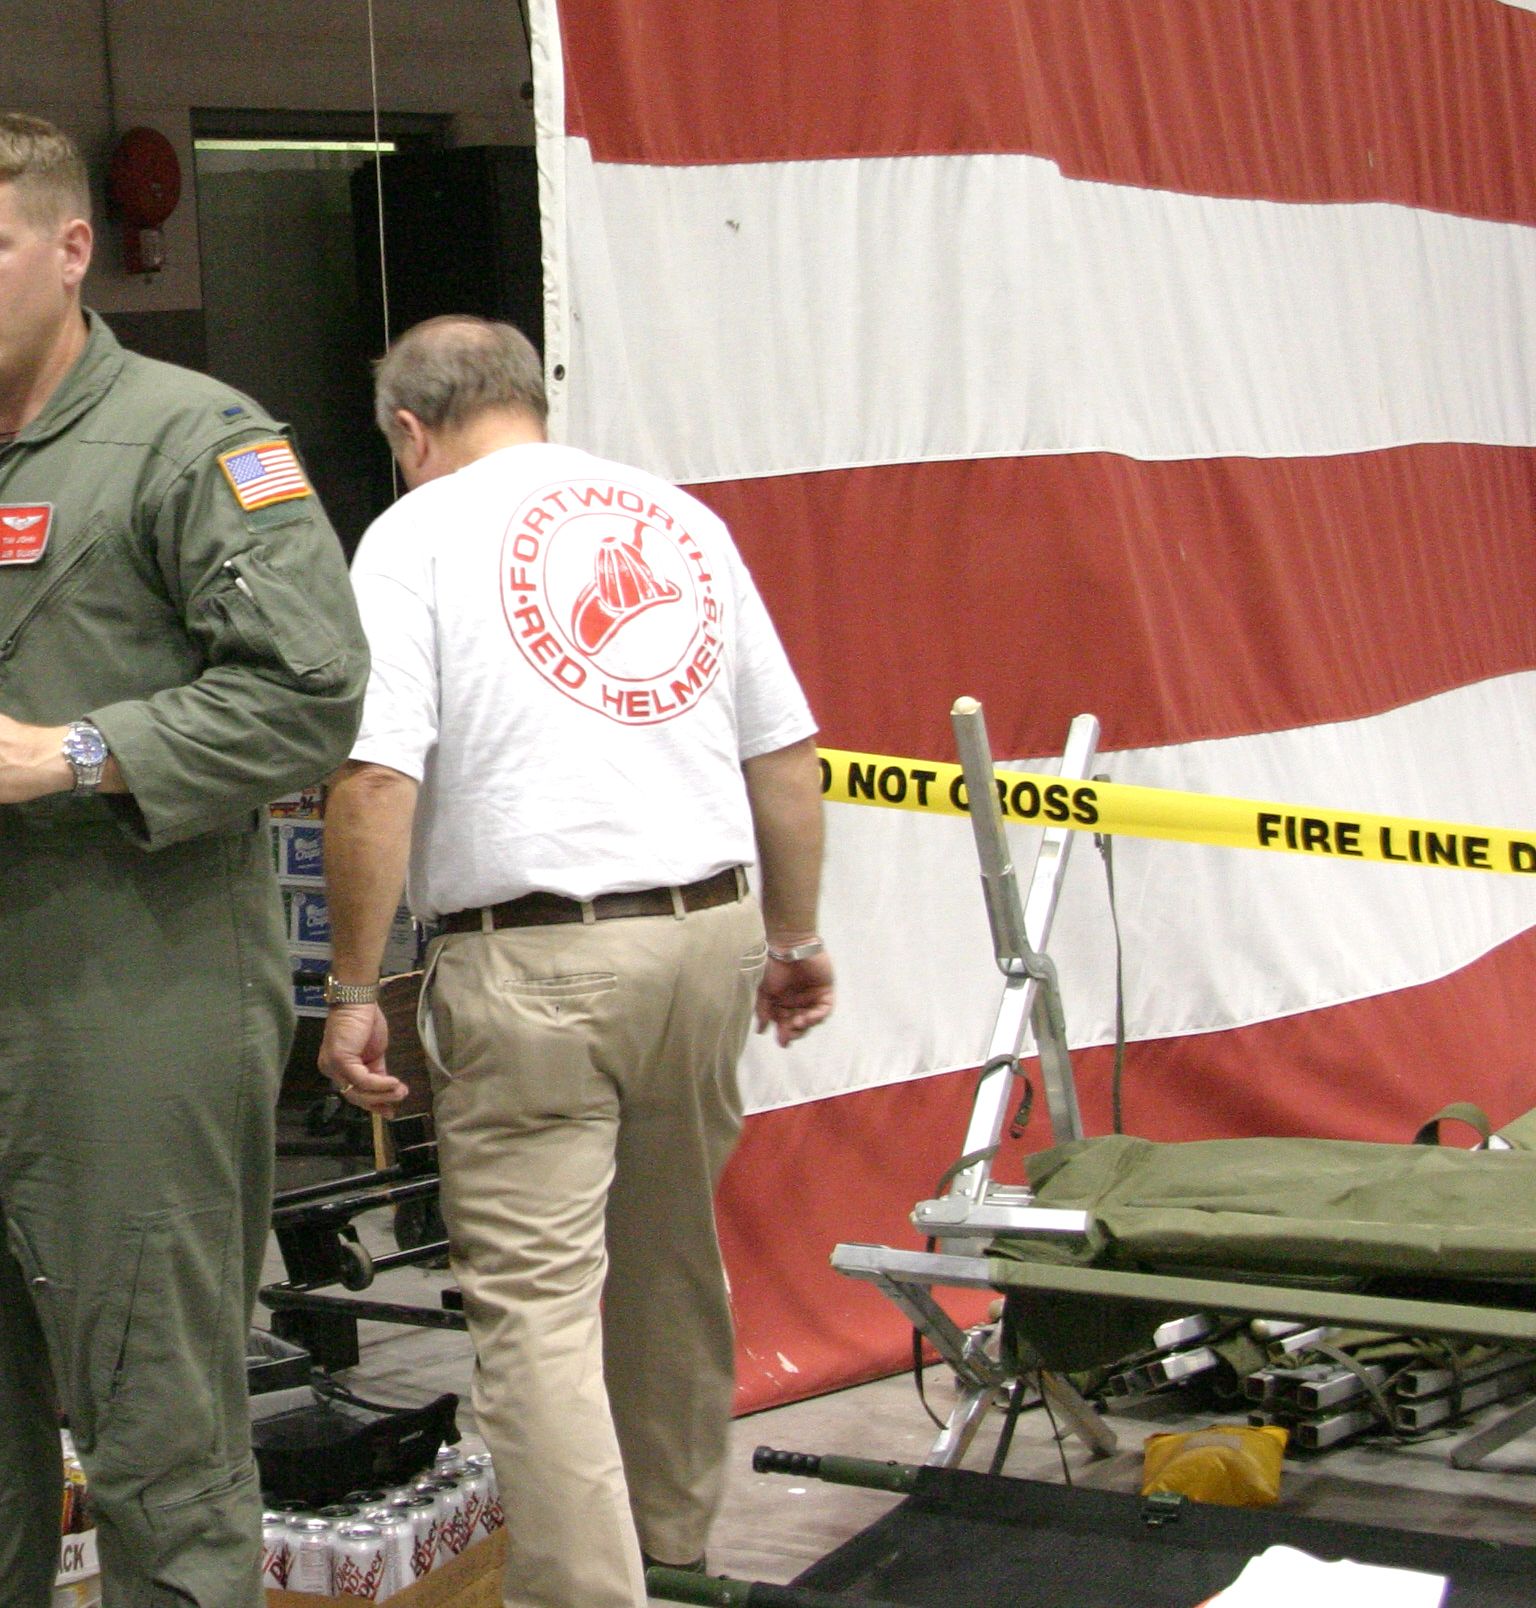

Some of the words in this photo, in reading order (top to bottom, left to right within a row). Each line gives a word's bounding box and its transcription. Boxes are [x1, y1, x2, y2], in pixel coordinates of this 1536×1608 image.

[510, 491, 569, 591] FORT
[568, 486, 713, 582] WORTH
[513, 604, 587, 689] RED
[848, 762, 936, 806] NOT
[1257, 812, 1363, 857] FIRE
[1379, 826, 1493, 870] LINE
